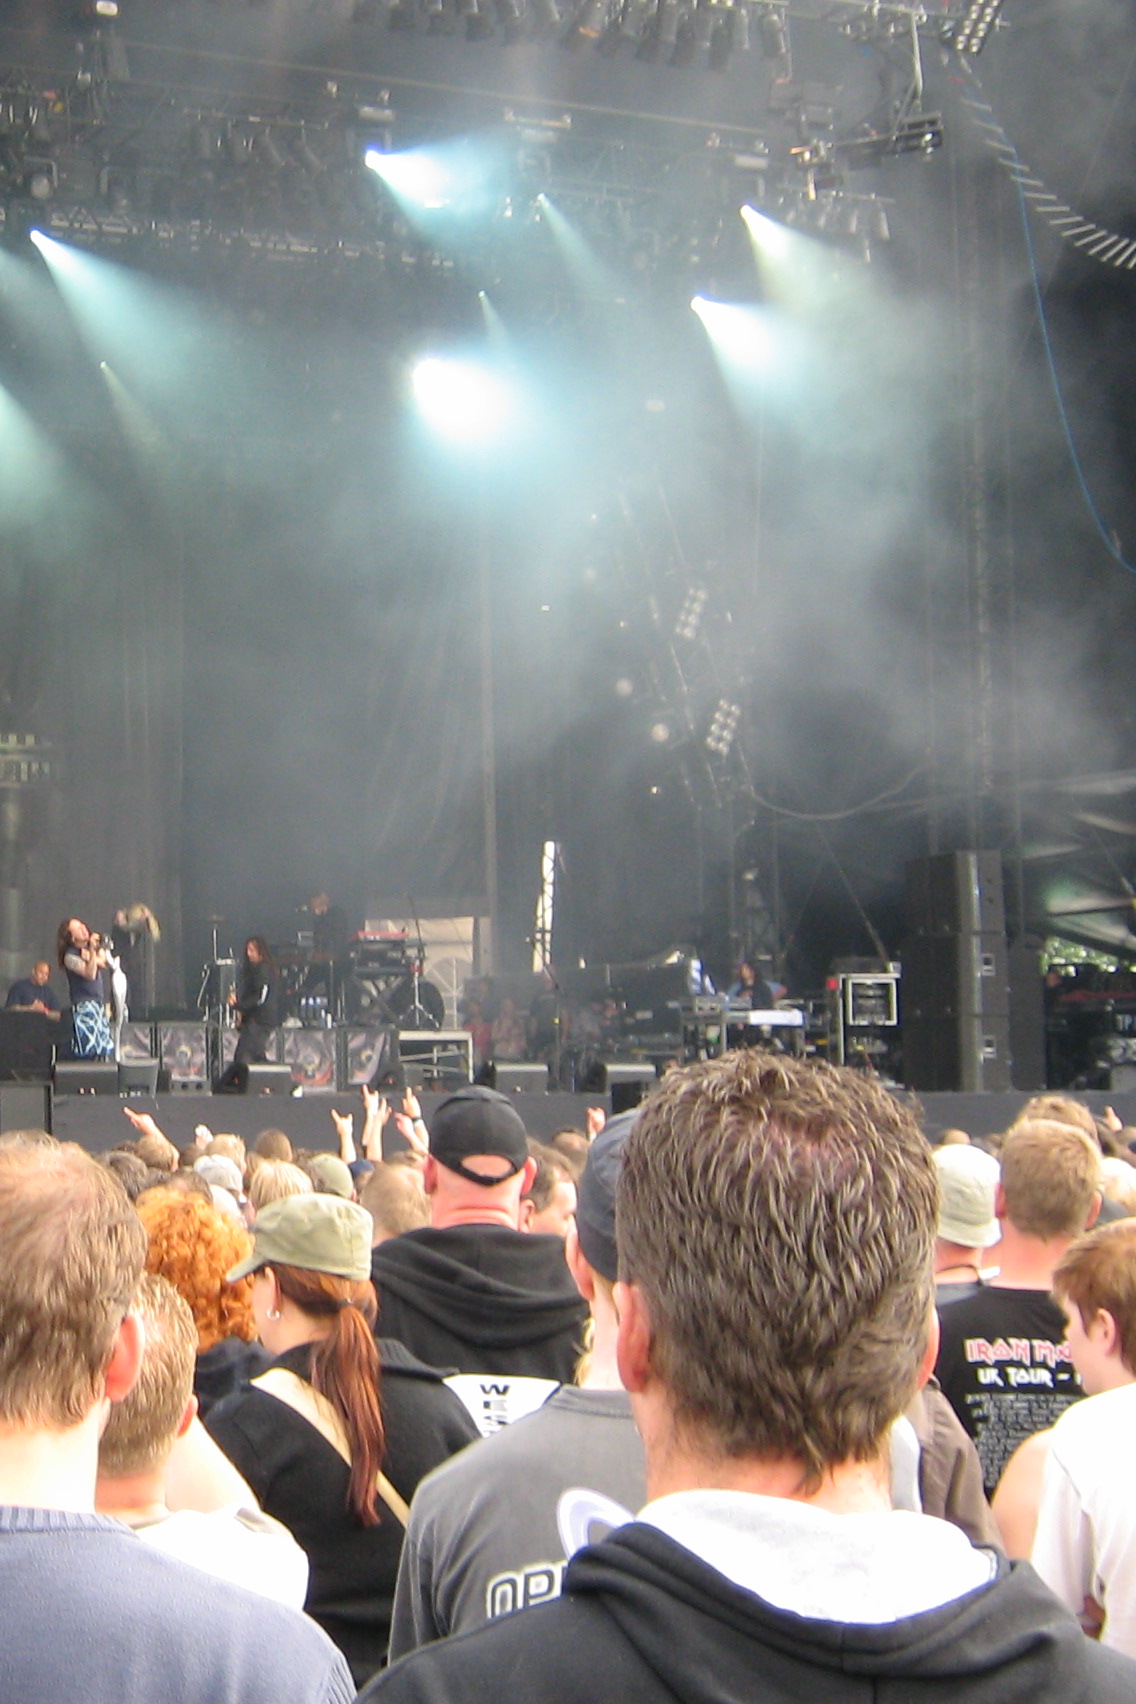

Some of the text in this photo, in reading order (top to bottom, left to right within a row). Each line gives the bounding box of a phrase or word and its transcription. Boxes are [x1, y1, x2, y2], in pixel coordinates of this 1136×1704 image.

[964, 1337, 1031, 1367] IRON
[977, 1367, 1004, 1387] UK
[1005, 1366, 1054, 1389] TOUR
